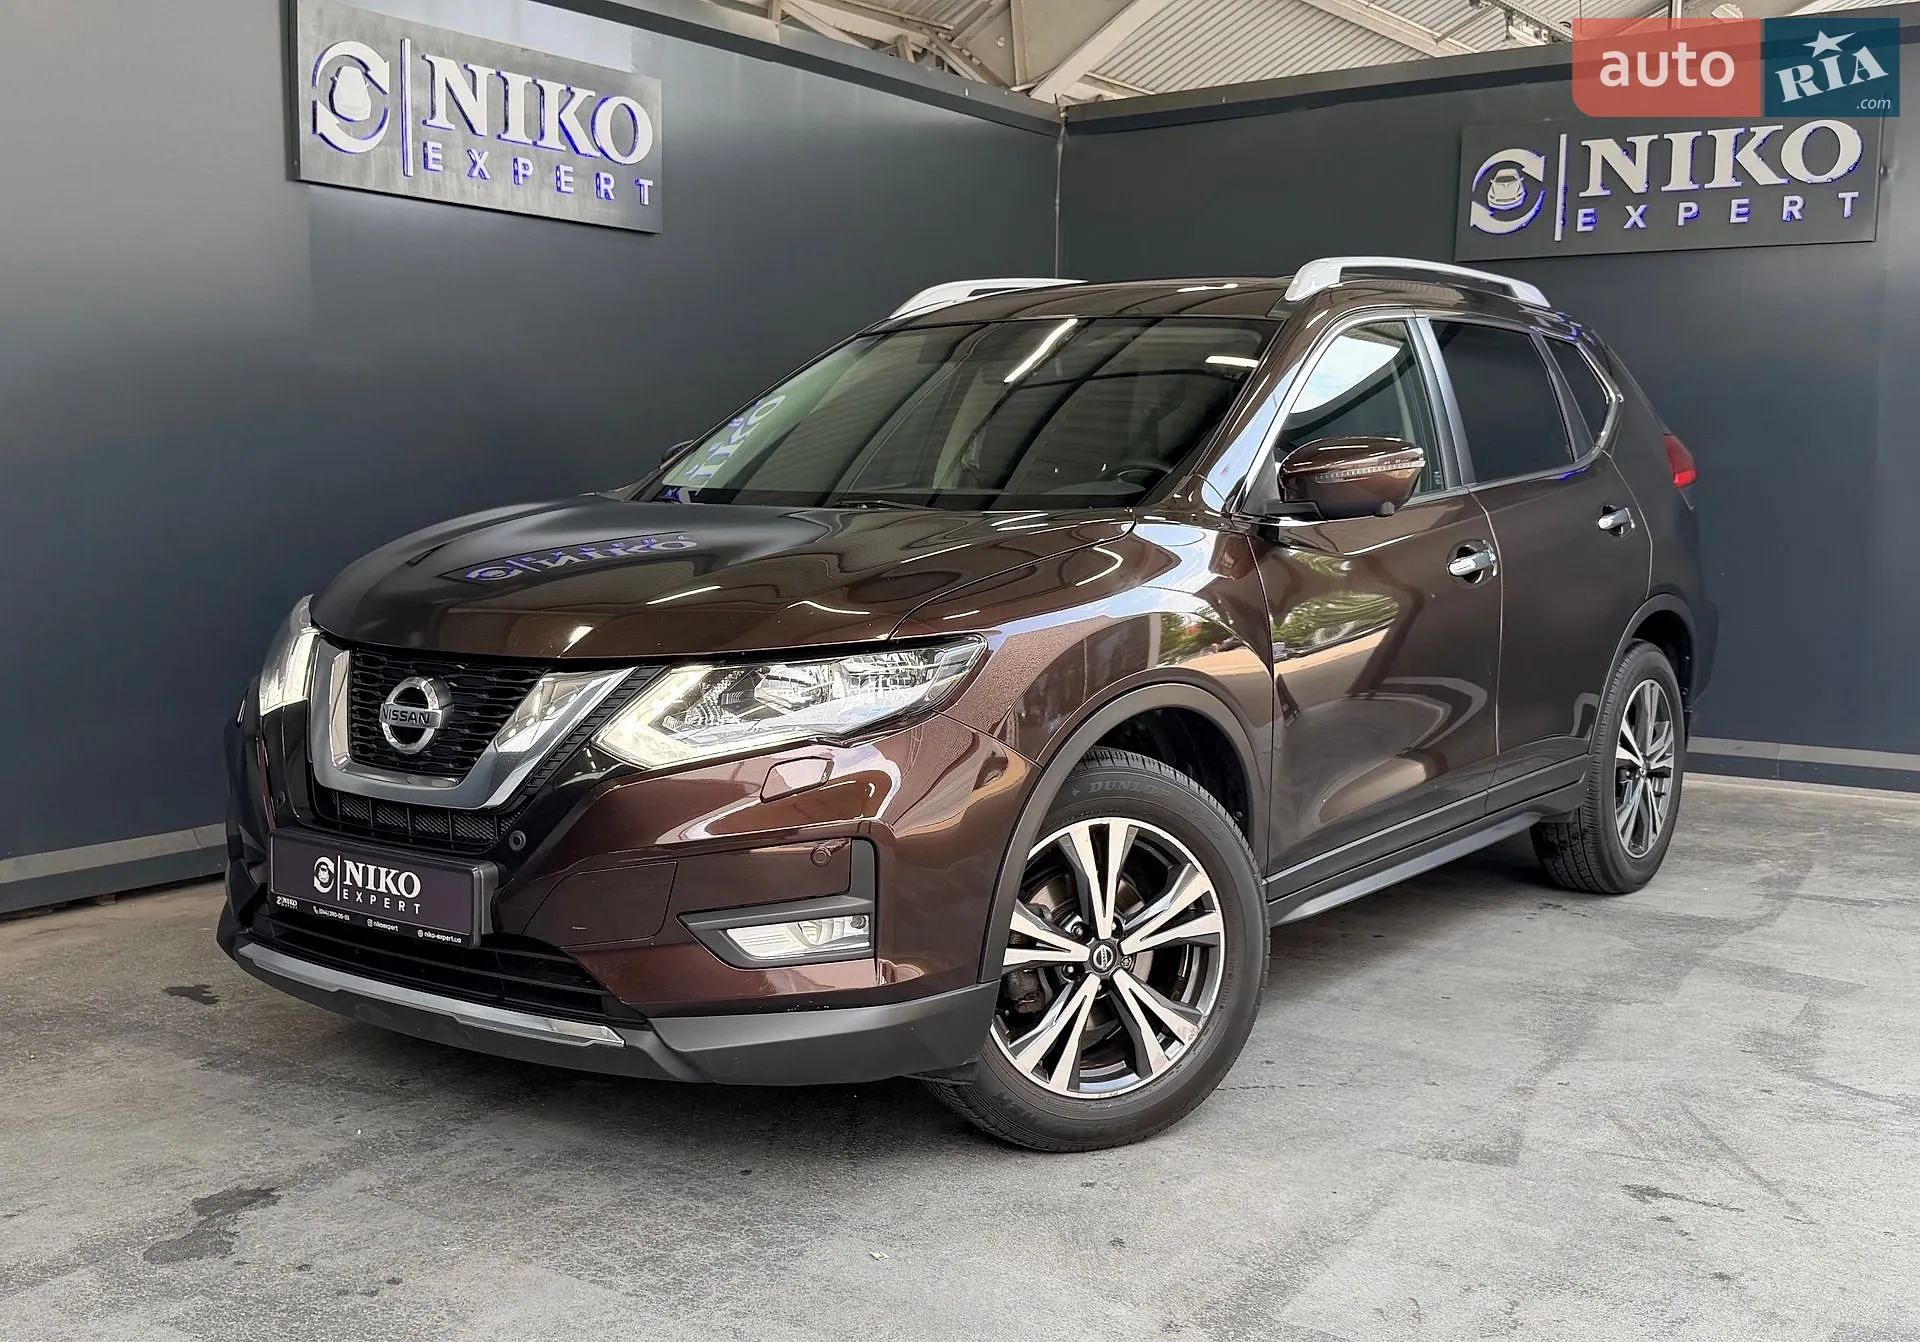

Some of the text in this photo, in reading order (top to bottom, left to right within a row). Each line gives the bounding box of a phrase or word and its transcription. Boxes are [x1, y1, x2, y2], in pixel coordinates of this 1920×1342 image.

[421, 53, 654, 166] NIKO
[422, 141, 654, 207] EXPERT
[1578, 119, 1863, 199] NIKO
[1576, 191, 1860, 232] EXPERT
[382, 706, 430, 726] NISSAN
[343, 859, 421, 899] NIKO
[343, 889, 421, 915] EXPERT
